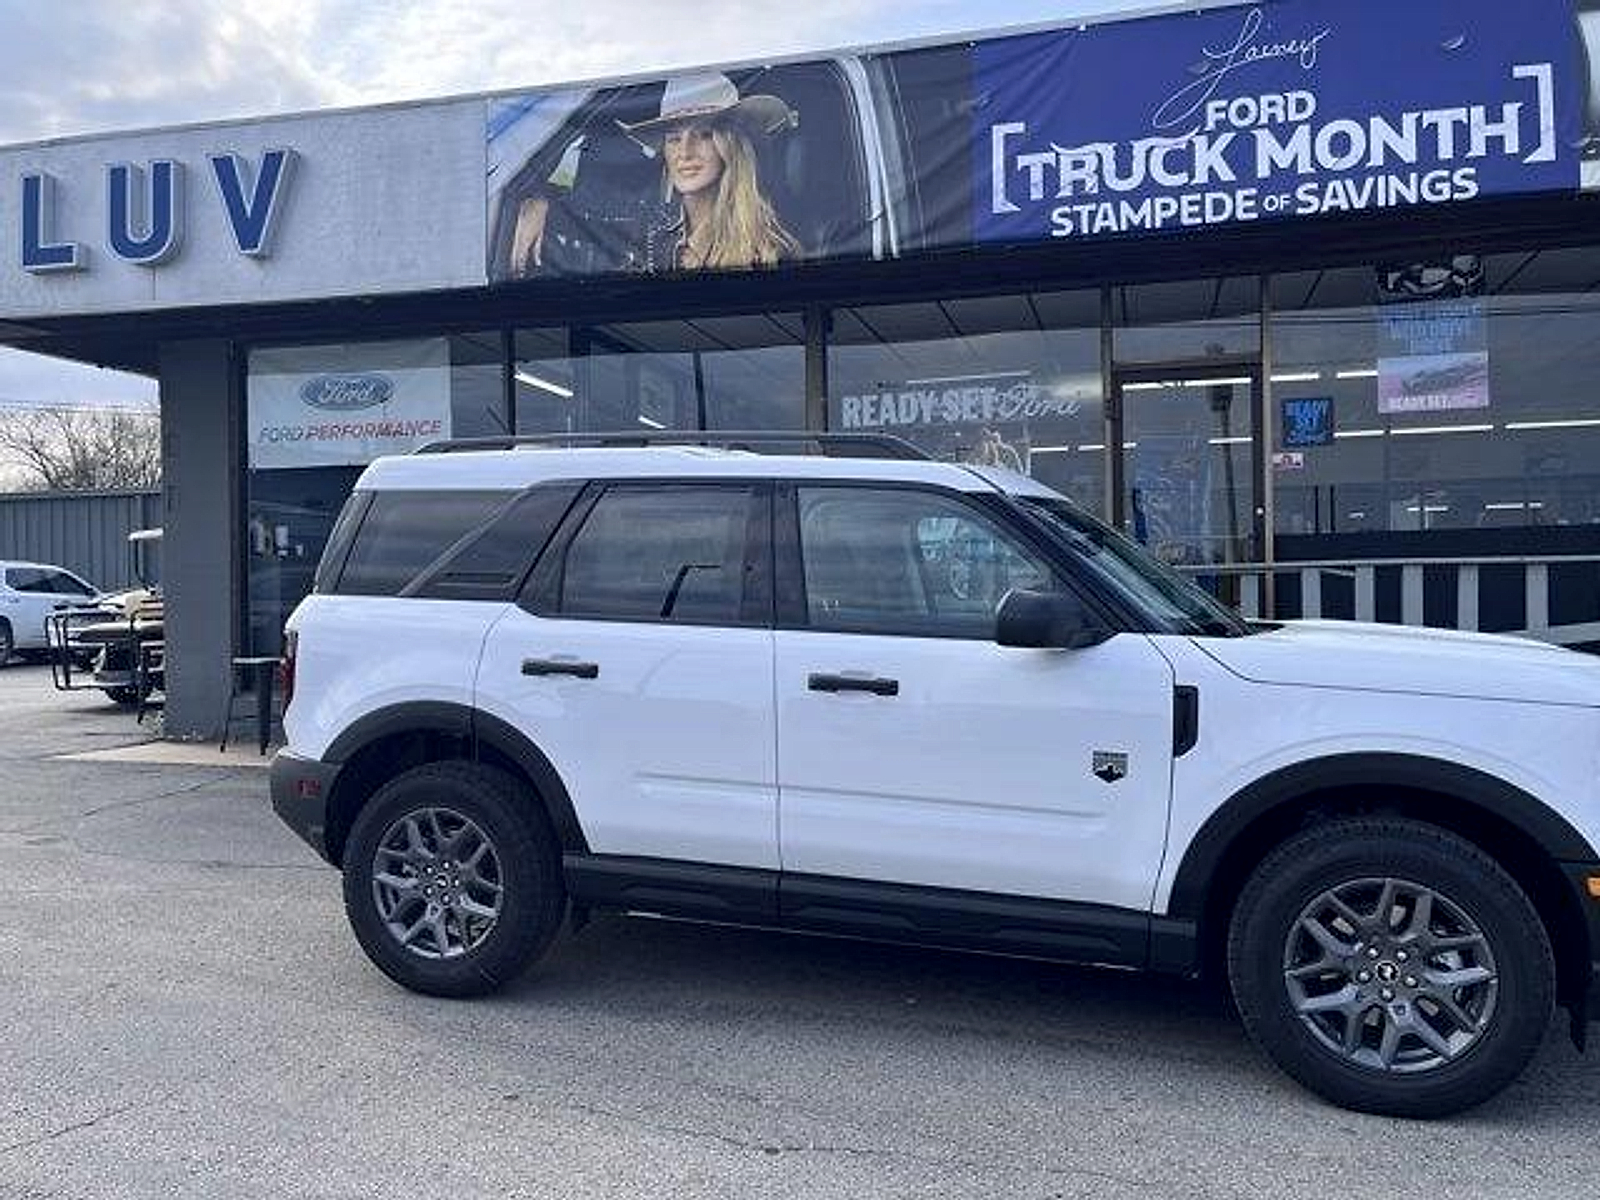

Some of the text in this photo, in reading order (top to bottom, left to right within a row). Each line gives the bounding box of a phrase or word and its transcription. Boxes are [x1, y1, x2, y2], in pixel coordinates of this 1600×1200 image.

[1206, 90, 1316, 132] FORD
[1017, 102, 1523, 201] TRUCK MONTH
[1051, 167, 1480, 236] STAMPEDE OF SAVINGS
[260, 419, 442, 442] FORD PERFORMANCE
